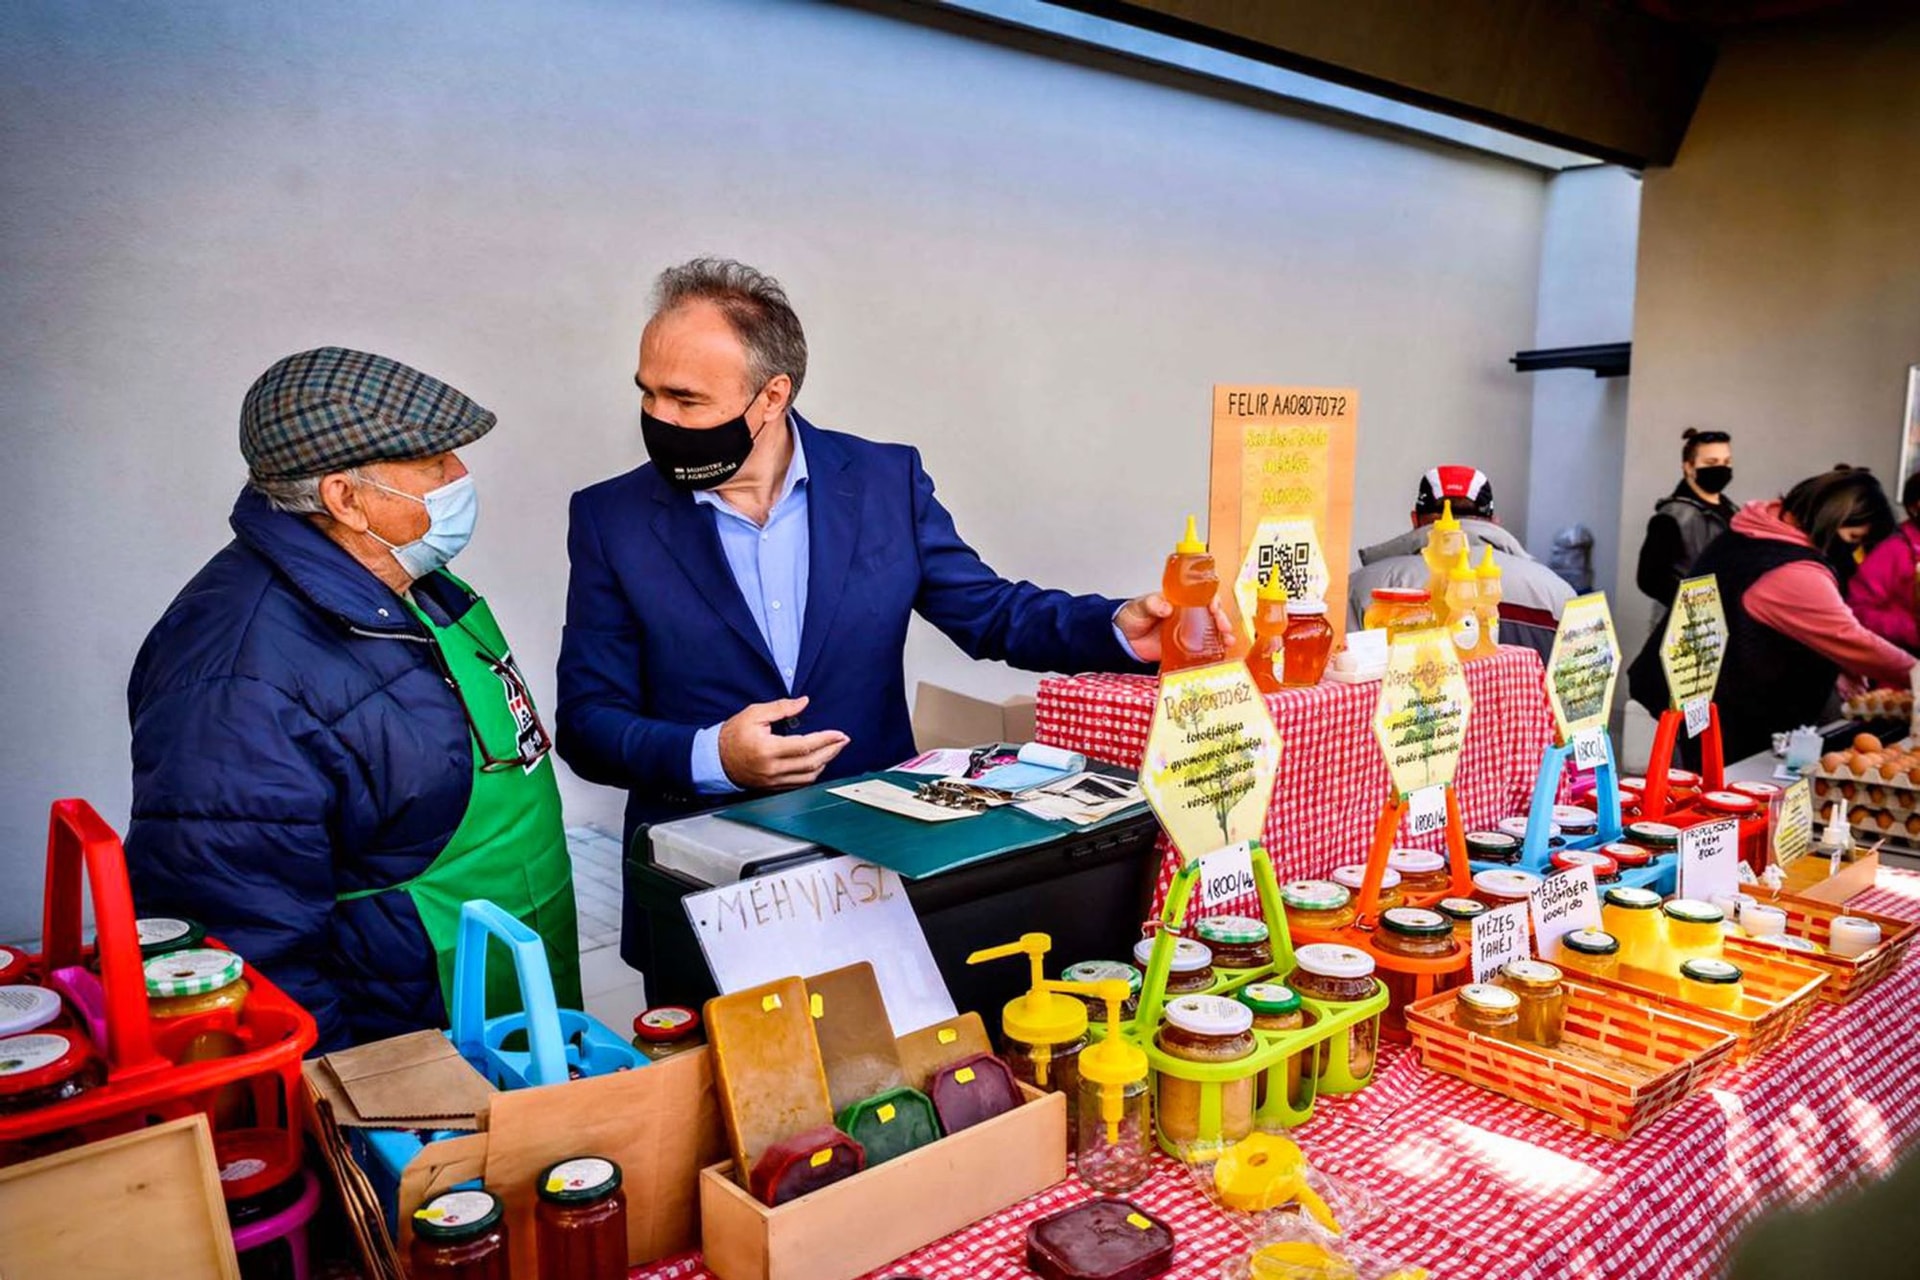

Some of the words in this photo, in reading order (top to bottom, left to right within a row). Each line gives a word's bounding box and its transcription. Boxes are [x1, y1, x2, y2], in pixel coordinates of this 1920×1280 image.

[1228, 392, 1269, 416] FELIR
[1271, 393, 1347, 416] AA0807072
[686, 462, 723, 473] MINISTRY
[687, 462, 737, 480] AGRICULTURE
[1478, 914, 1515, 940] MÉZES
